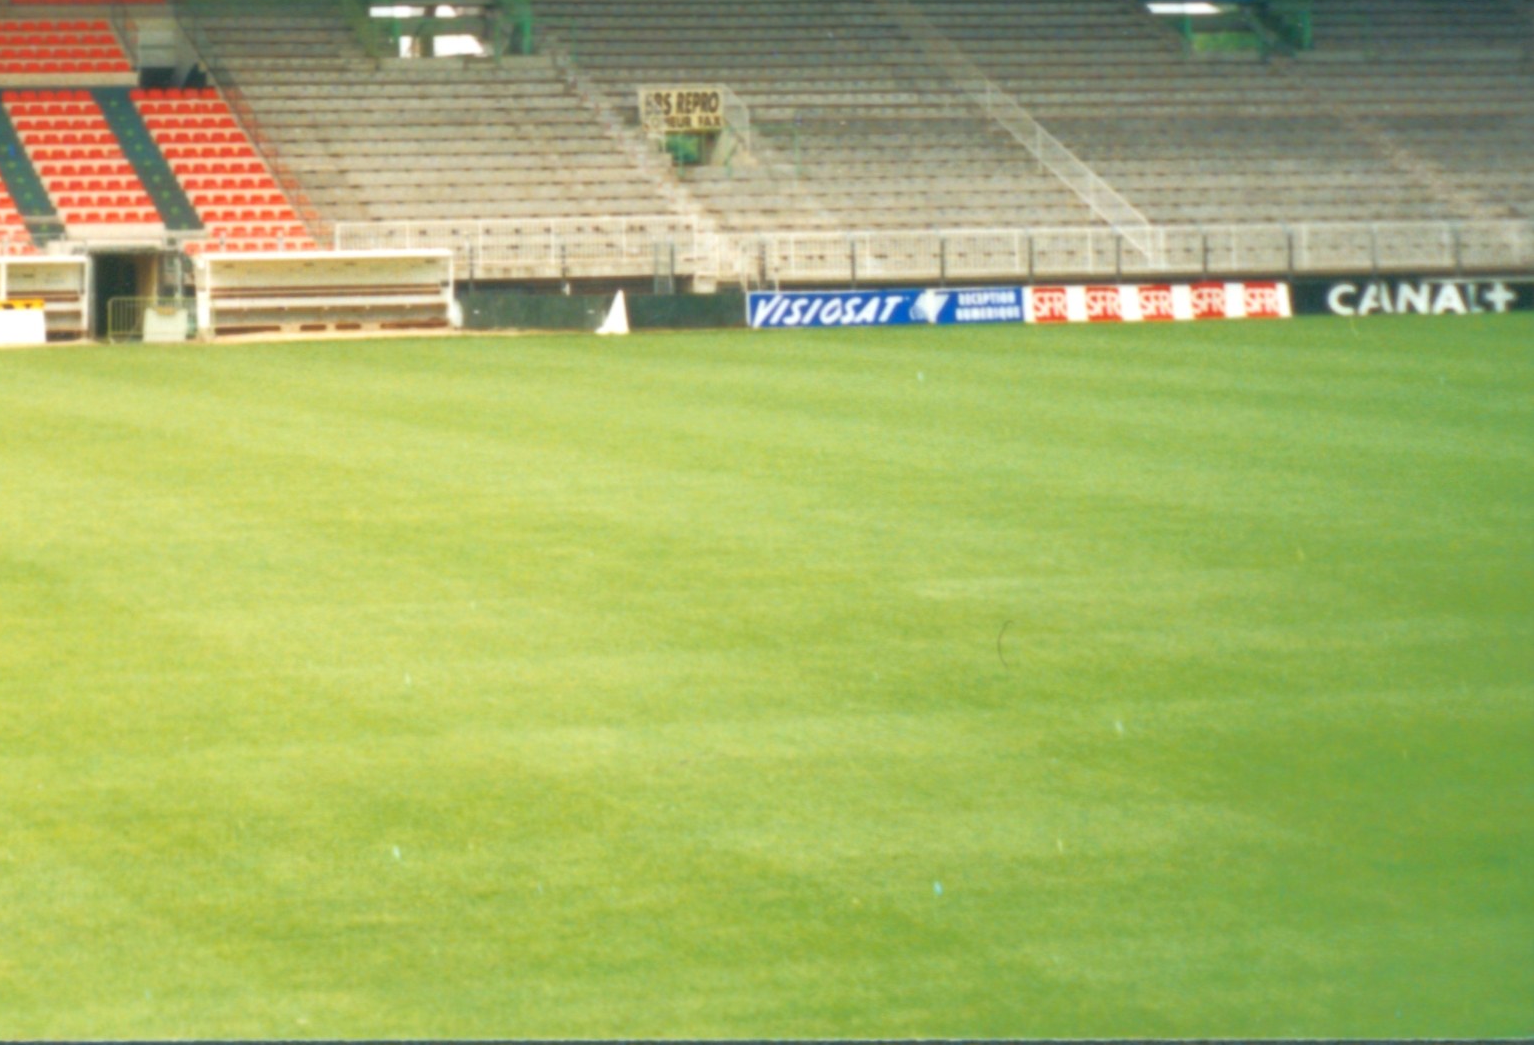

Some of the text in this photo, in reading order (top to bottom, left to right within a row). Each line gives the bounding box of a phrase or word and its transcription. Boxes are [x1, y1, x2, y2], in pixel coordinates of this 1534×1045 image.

[676, 91, 719, 114] REPRO
[752, 295, 903, 328] VISIOSAT
[1033, 288, 1278, 316] SFR SFR SFR SFR SFR
[1327, 284, 1517, 317] CANAL+
